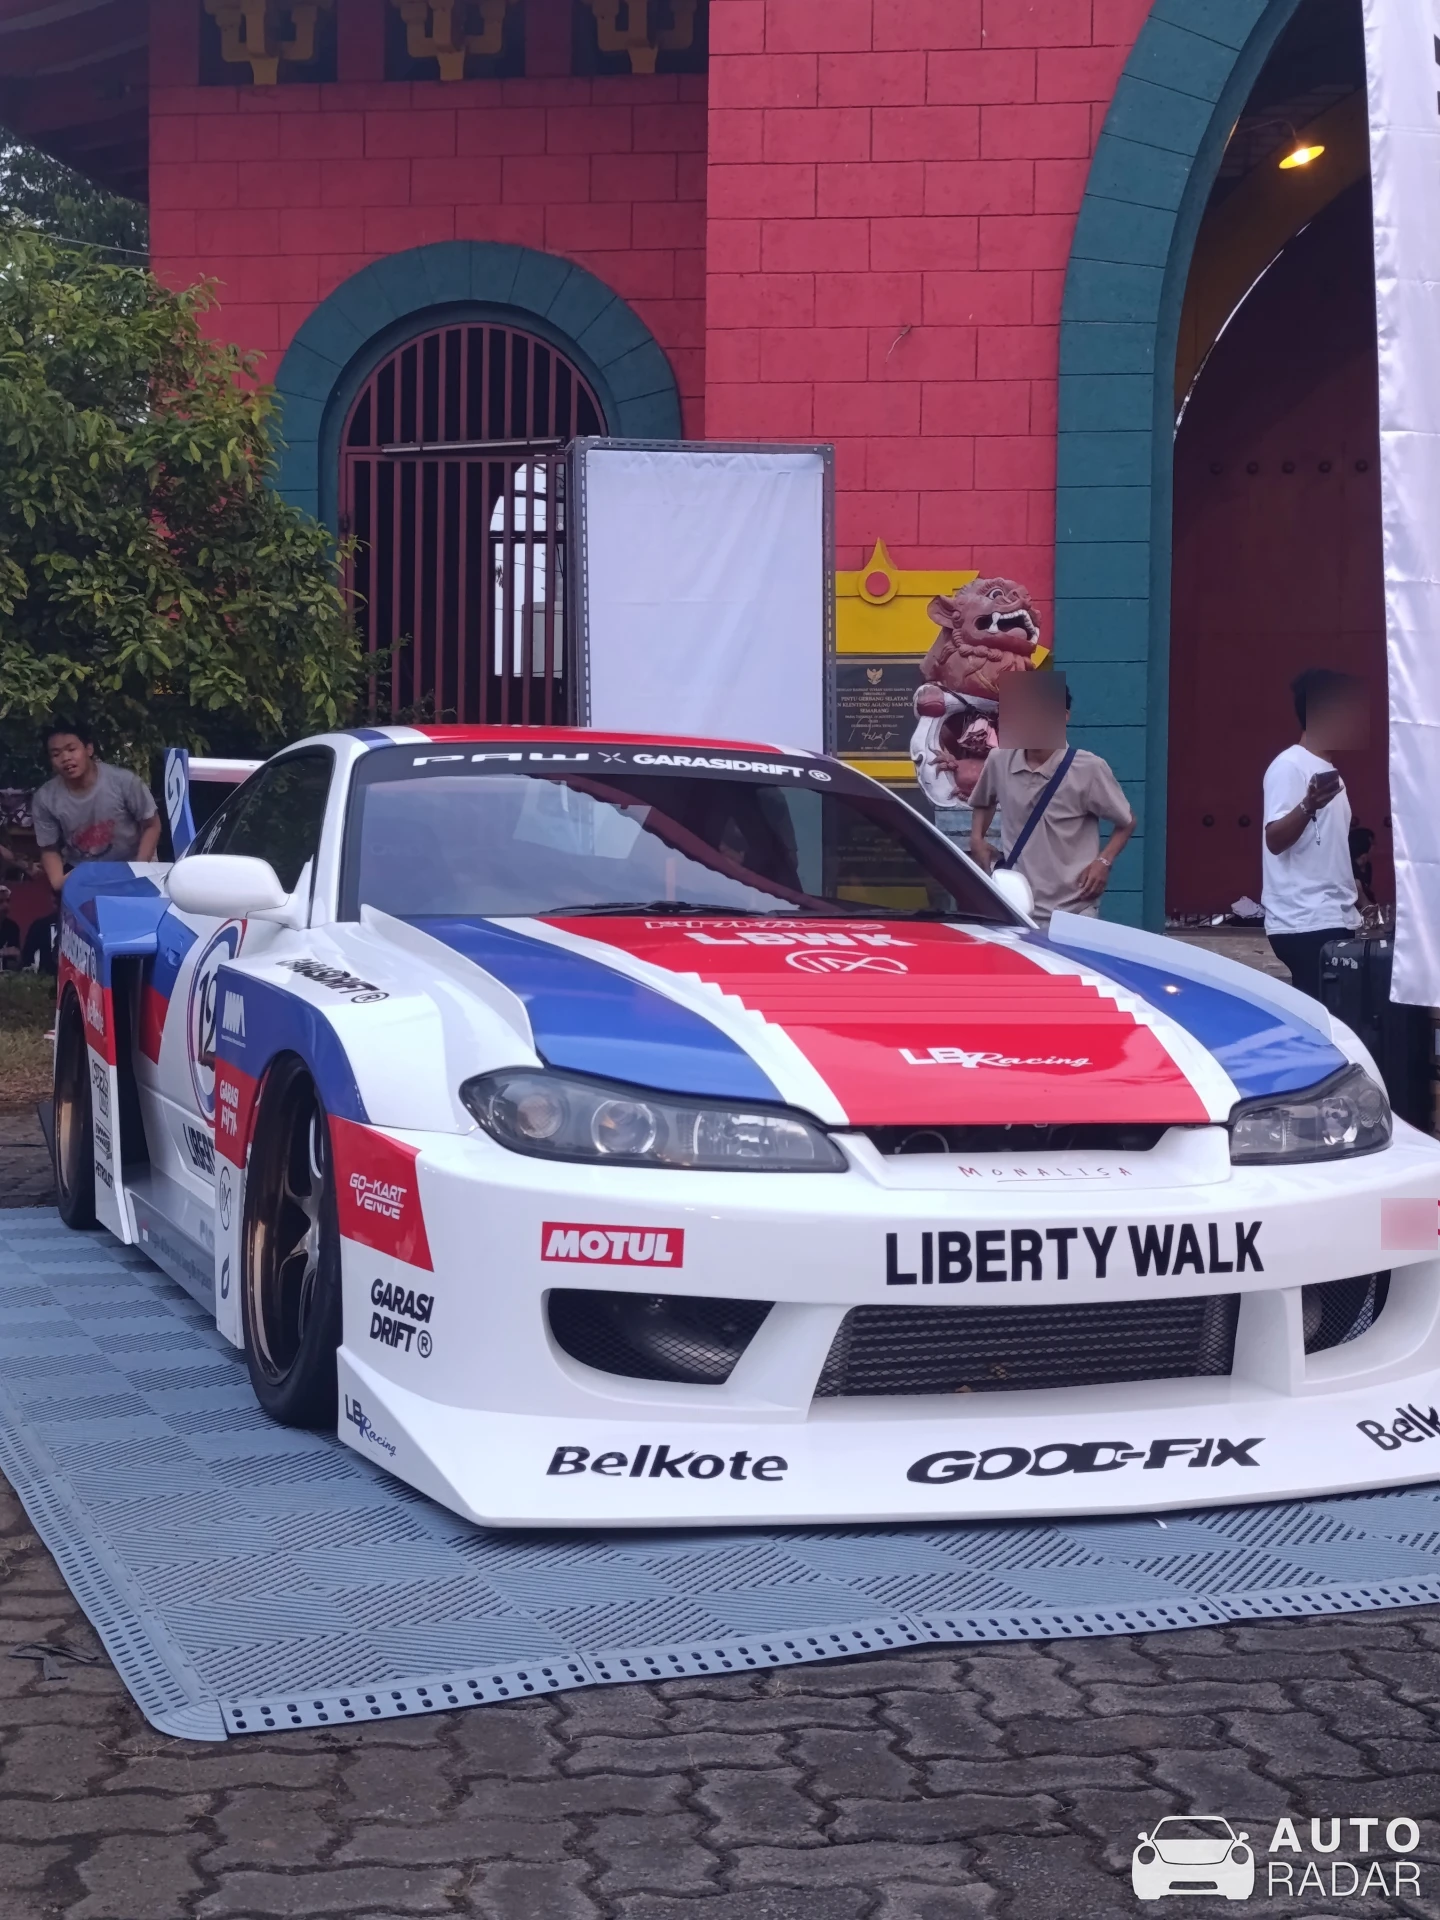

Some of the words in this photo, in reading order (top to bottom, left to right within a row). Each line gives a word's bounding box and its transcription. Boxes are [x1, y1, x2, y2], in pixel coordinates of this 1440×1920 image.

[633, 753, 803, 779] GARASIDRIFT
[683, 932, 918, 947] LBWK
[219, 1079, 240, 1109] GARASI
[349, 1172, 407, 1203] GO-KART
[957, 1165, 1133, 1179] MONALISA
[545, 1229, 674, 1262] MOTUL
[885, 1225, 1118, 1286] LIBERTY
[1127, 1221, 1265, 1277] WALK
[370, 1278, 435, 1323] GARASI
[369, 1311, 417, 1352] DRIFT
[546, 1444, 789, 1481] Belkote
[906, 1437, 1266, 1485] GOOD-FIX
